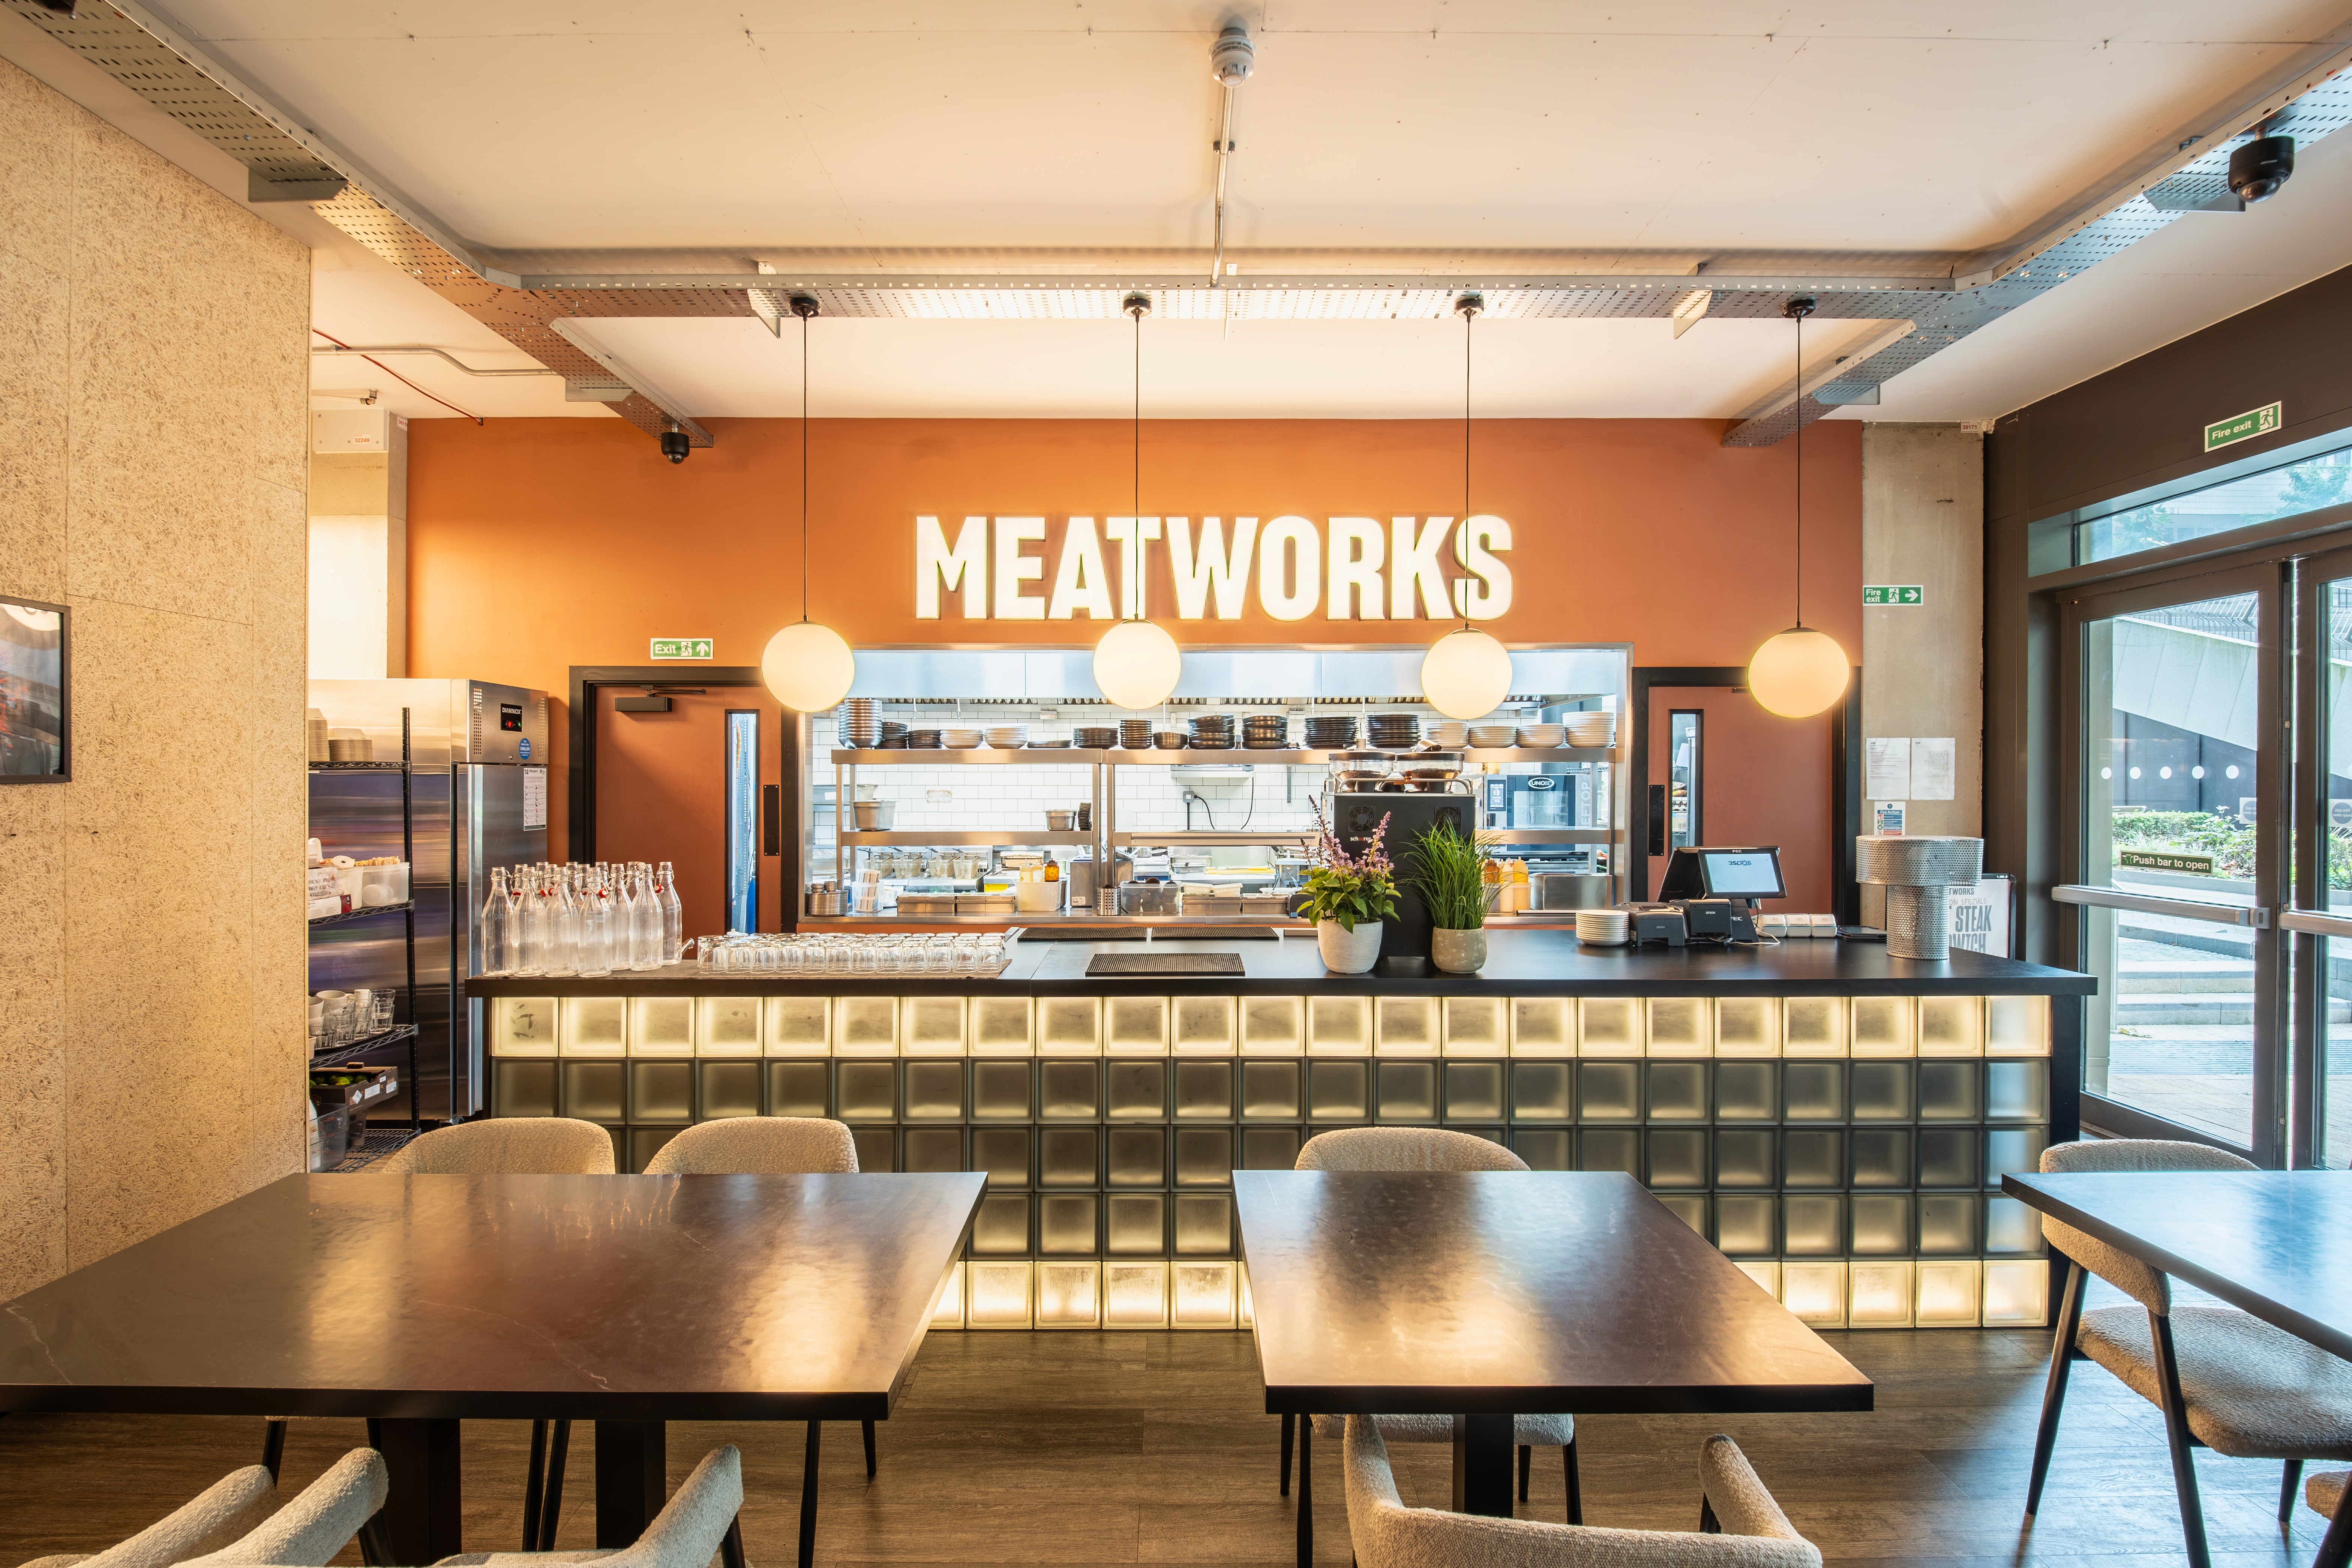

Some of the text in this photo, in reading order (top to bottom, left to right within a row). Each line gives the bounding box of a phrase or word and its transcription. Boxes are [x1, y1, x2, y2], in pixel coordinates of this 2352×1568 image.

[2212, 420, 2252, 440] Fire exit
[915, 515, 1512, 620] MEATWORKS
[655, 644, 676, 654] Exit
[2133, 855, 2209, 871] Push bar to open
[1955, 905, 1992, 932] STEAK
